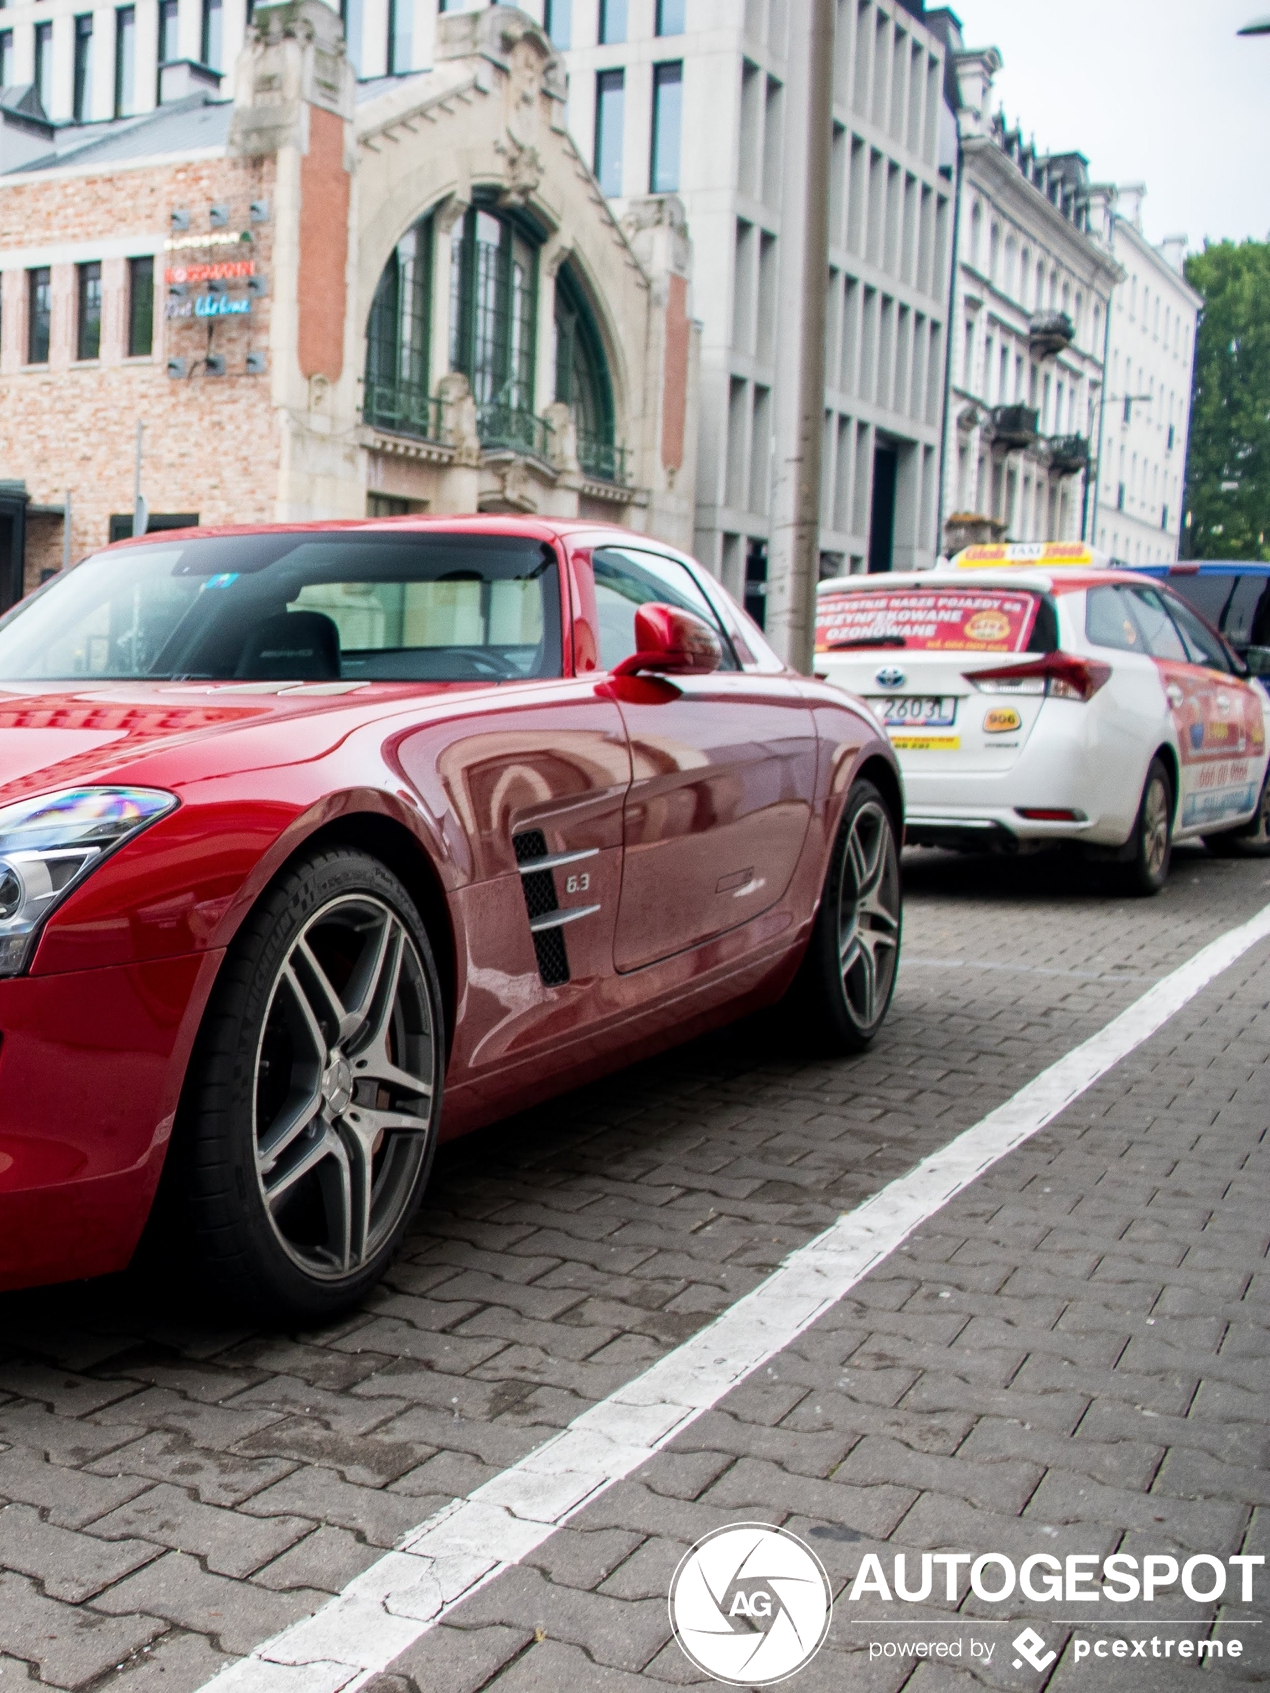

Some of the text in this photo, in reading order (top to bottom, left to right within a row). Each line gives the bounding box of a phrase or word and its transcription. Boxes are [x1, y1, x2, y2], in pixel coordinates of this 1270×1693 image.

[1011, 544, 1041, 556] TAXI
[890, 597, 936, 608] NASZE
[937, 597, 1001, 610] POJAZDY
[816, 609, 964, 626] DEZYNFEKOWANE
[826, 624, 938, 640] OZONOWANE
[884, 699, 949, 720] 2603L
[566, 873, 590, 893] 6.3
